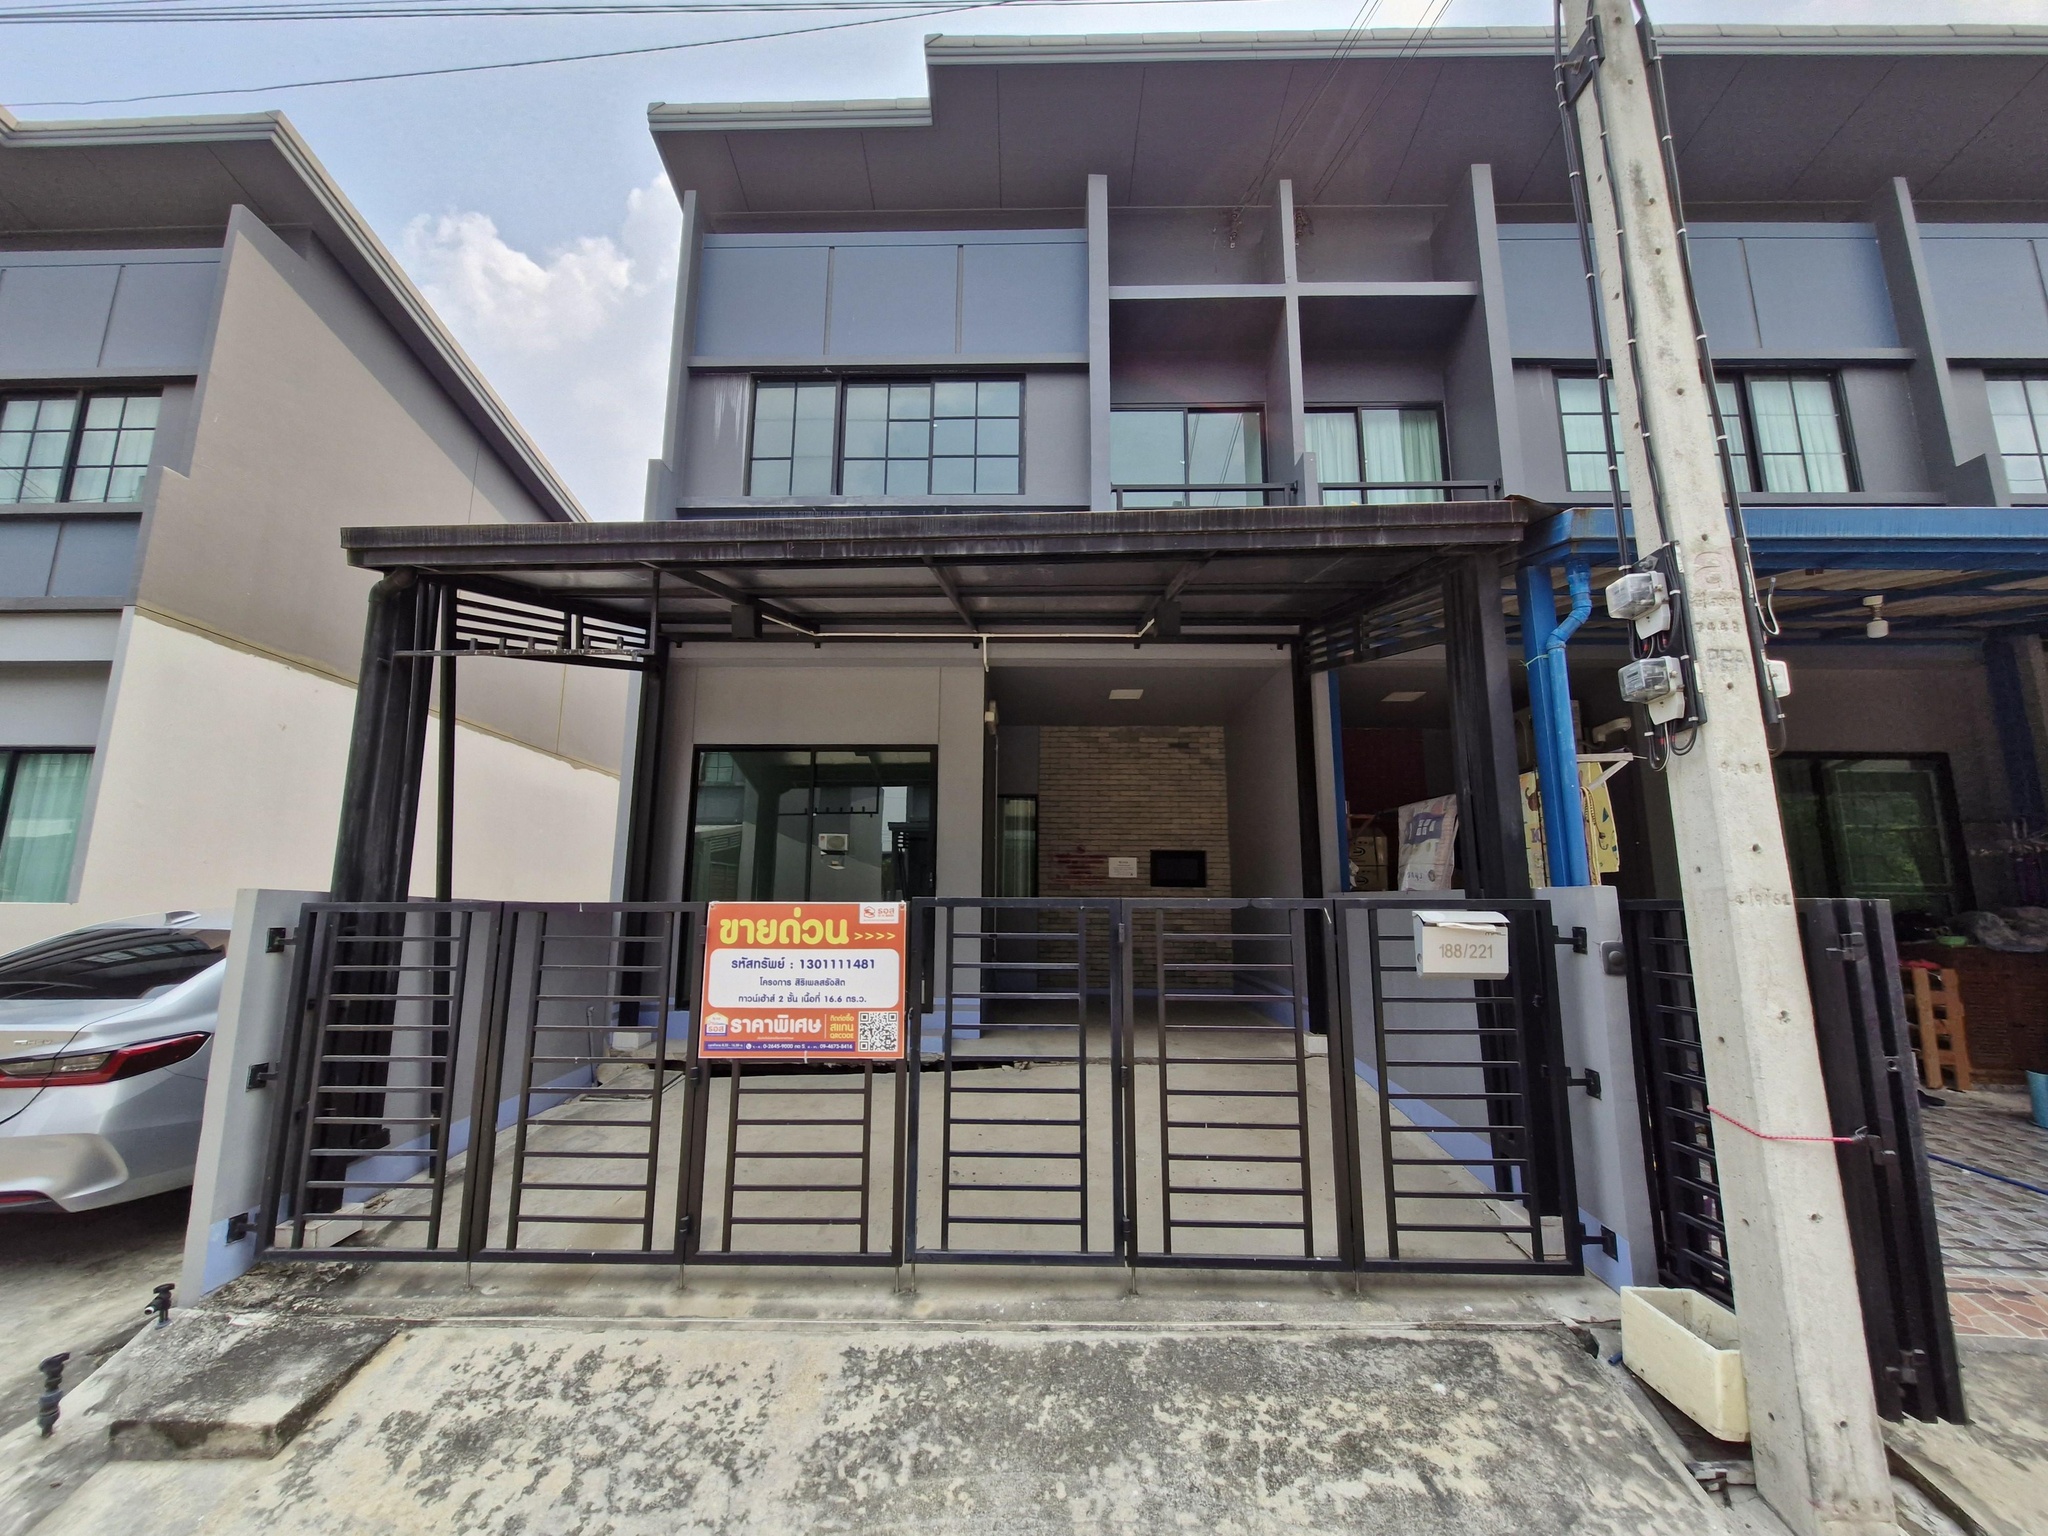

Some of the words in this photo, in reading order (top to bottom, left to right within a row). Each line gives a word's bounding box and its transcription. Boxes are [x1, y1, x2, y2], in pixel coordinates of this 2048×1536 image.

[719, 906, 850, 945] ขายด่วน
[1439, 943, 1494, 959] 188/221
[731, 956, 786, 970] รหัสทรัพย์
[799, 959, 876, 970] 1301111481
[759, 976, 792, 987] โครงการ
[778, 995, 784, 1003] 2
[786, 993, 798, 1003] ชั้น
[824, 995, 843, 1003] 16.6
[730, 1014, 822, 1034] ราคาพิเศษ
